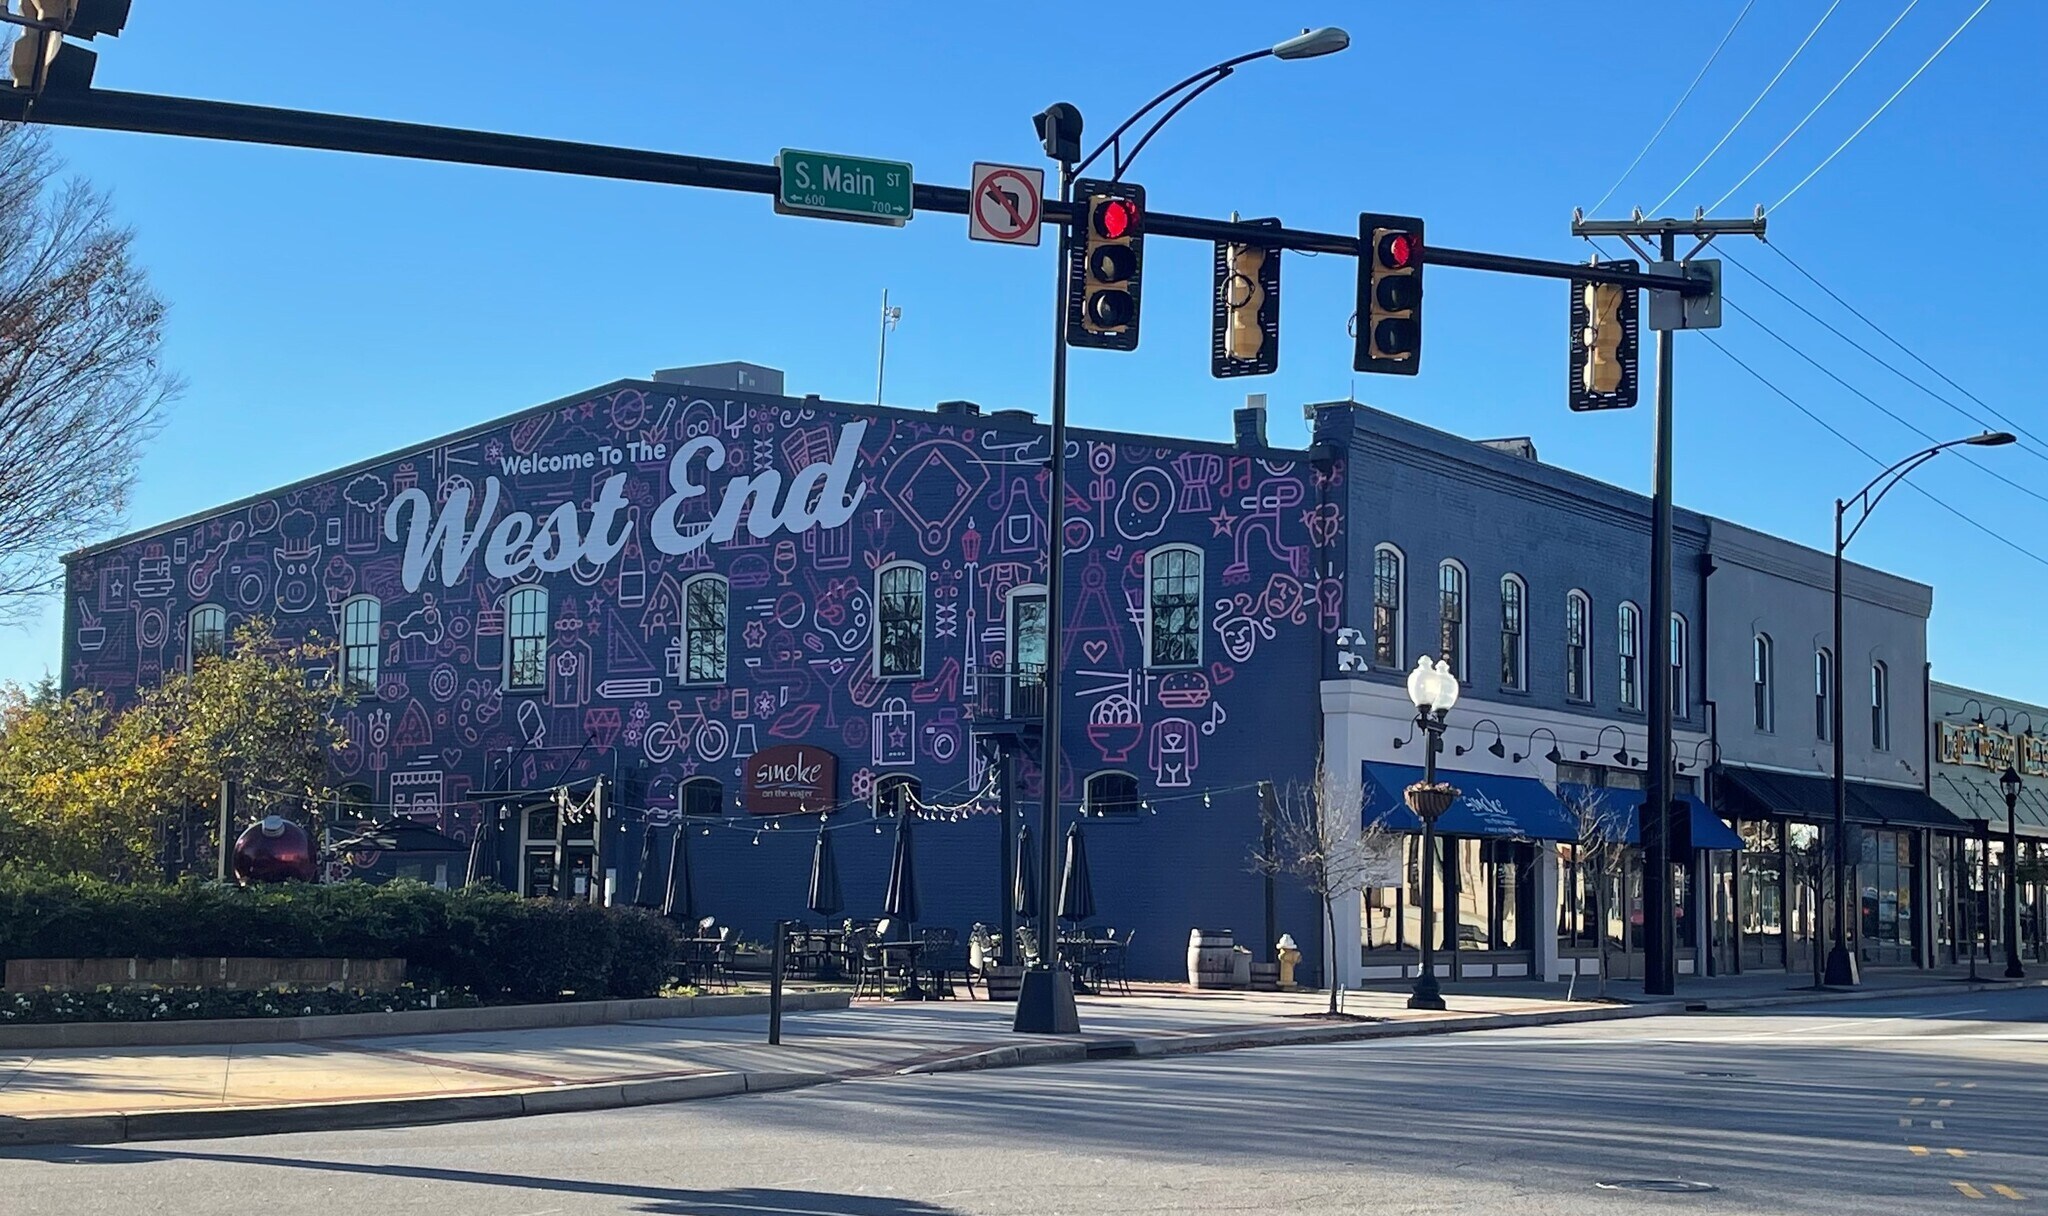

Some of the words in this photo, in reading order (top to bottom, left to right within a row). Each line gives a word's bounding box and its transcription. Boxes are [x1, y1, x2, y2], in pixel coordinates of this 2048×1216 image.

[795, 161, 817, 190] S.
[823, 164, 874, 196] Main
[886, 172, 901, 187] ST
[804, 194, 825, 206] 600
[872, 200, 892, 213] 700
[501, 454, 595, 476] Welcome
[598, 445, 624, 466] To
[626, 440, 668, 463] The
[384, 472, 633, 594] West
[650, 419, 868, 555] End
[757, 752, 821, 784] smoke
[762, 790, 773, 798] on
[774, 789, 788, 797] the
